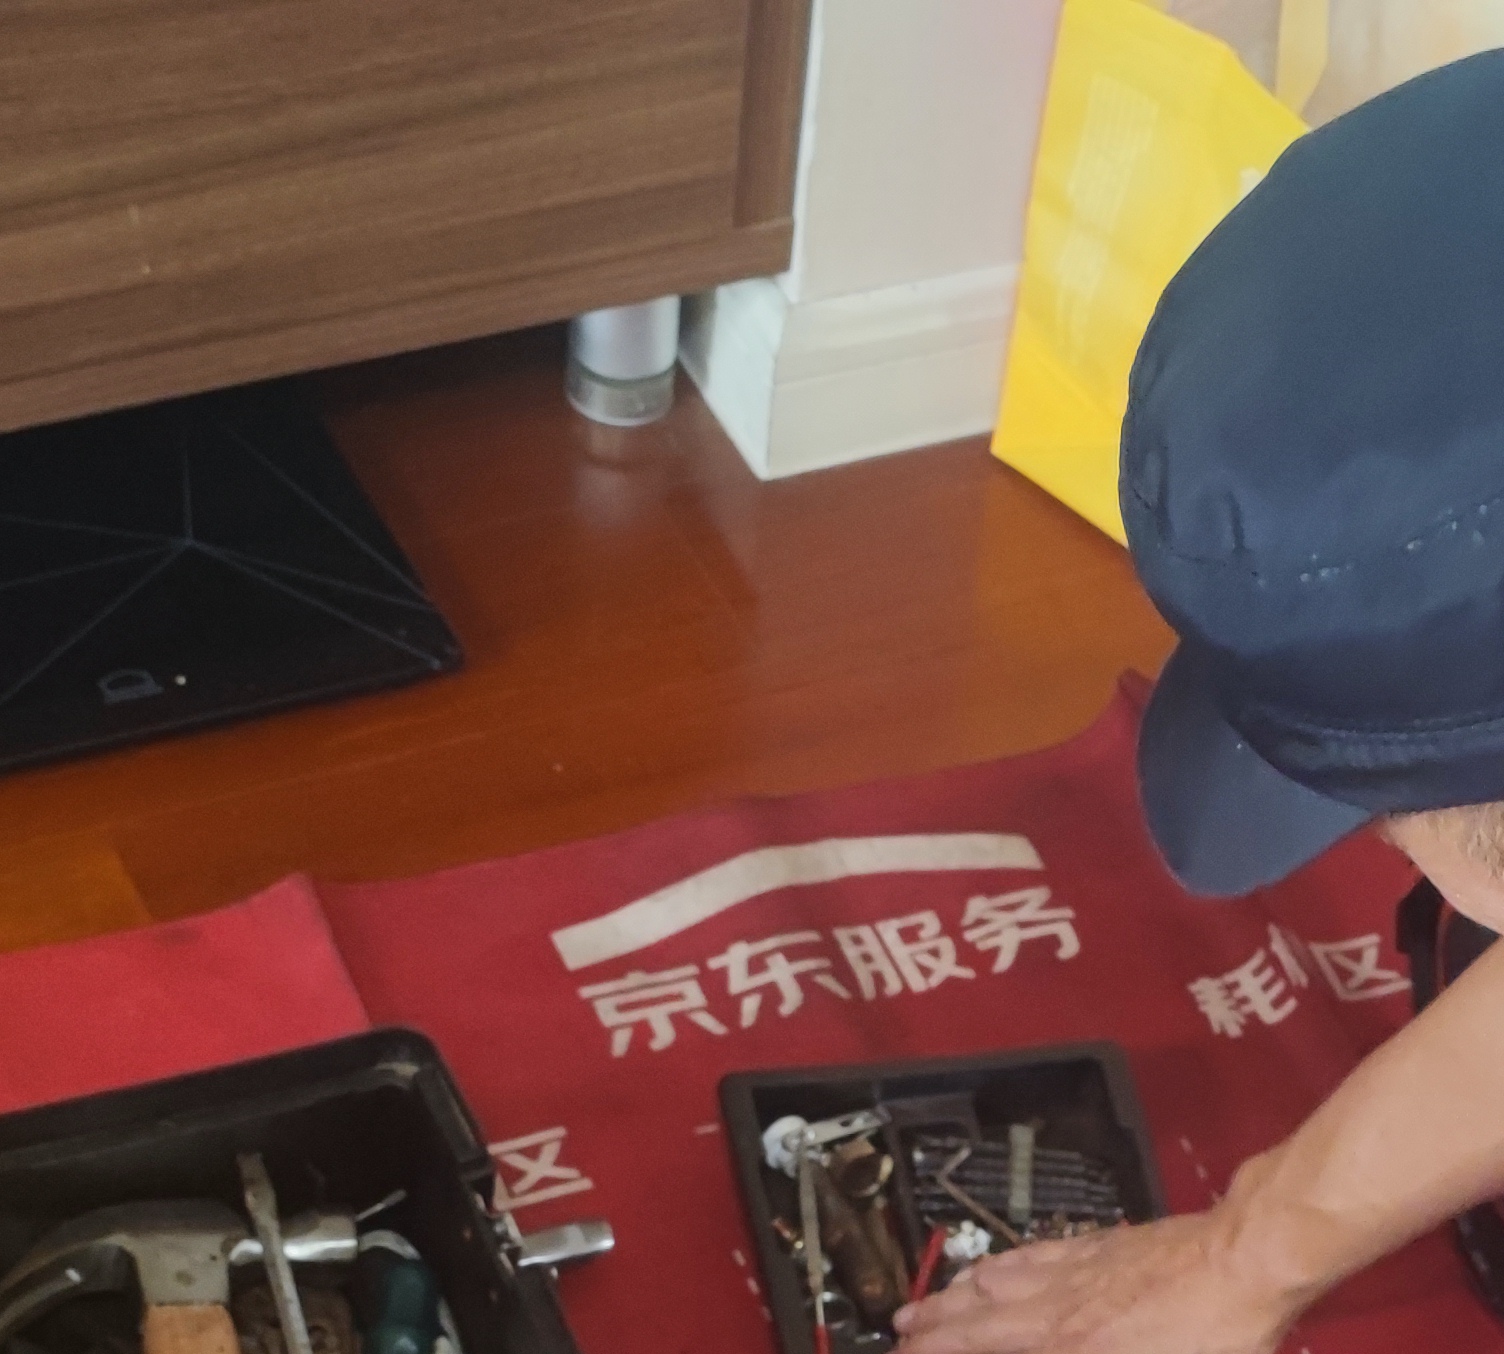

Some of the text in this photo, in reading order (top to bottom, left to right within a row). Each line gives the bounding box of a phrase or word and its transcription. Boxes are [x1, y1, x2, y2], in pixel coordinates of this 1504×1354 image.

[577, 885, 1082, 1058] 京东服务
[1186, 921, 1413, 1040] 耗区
